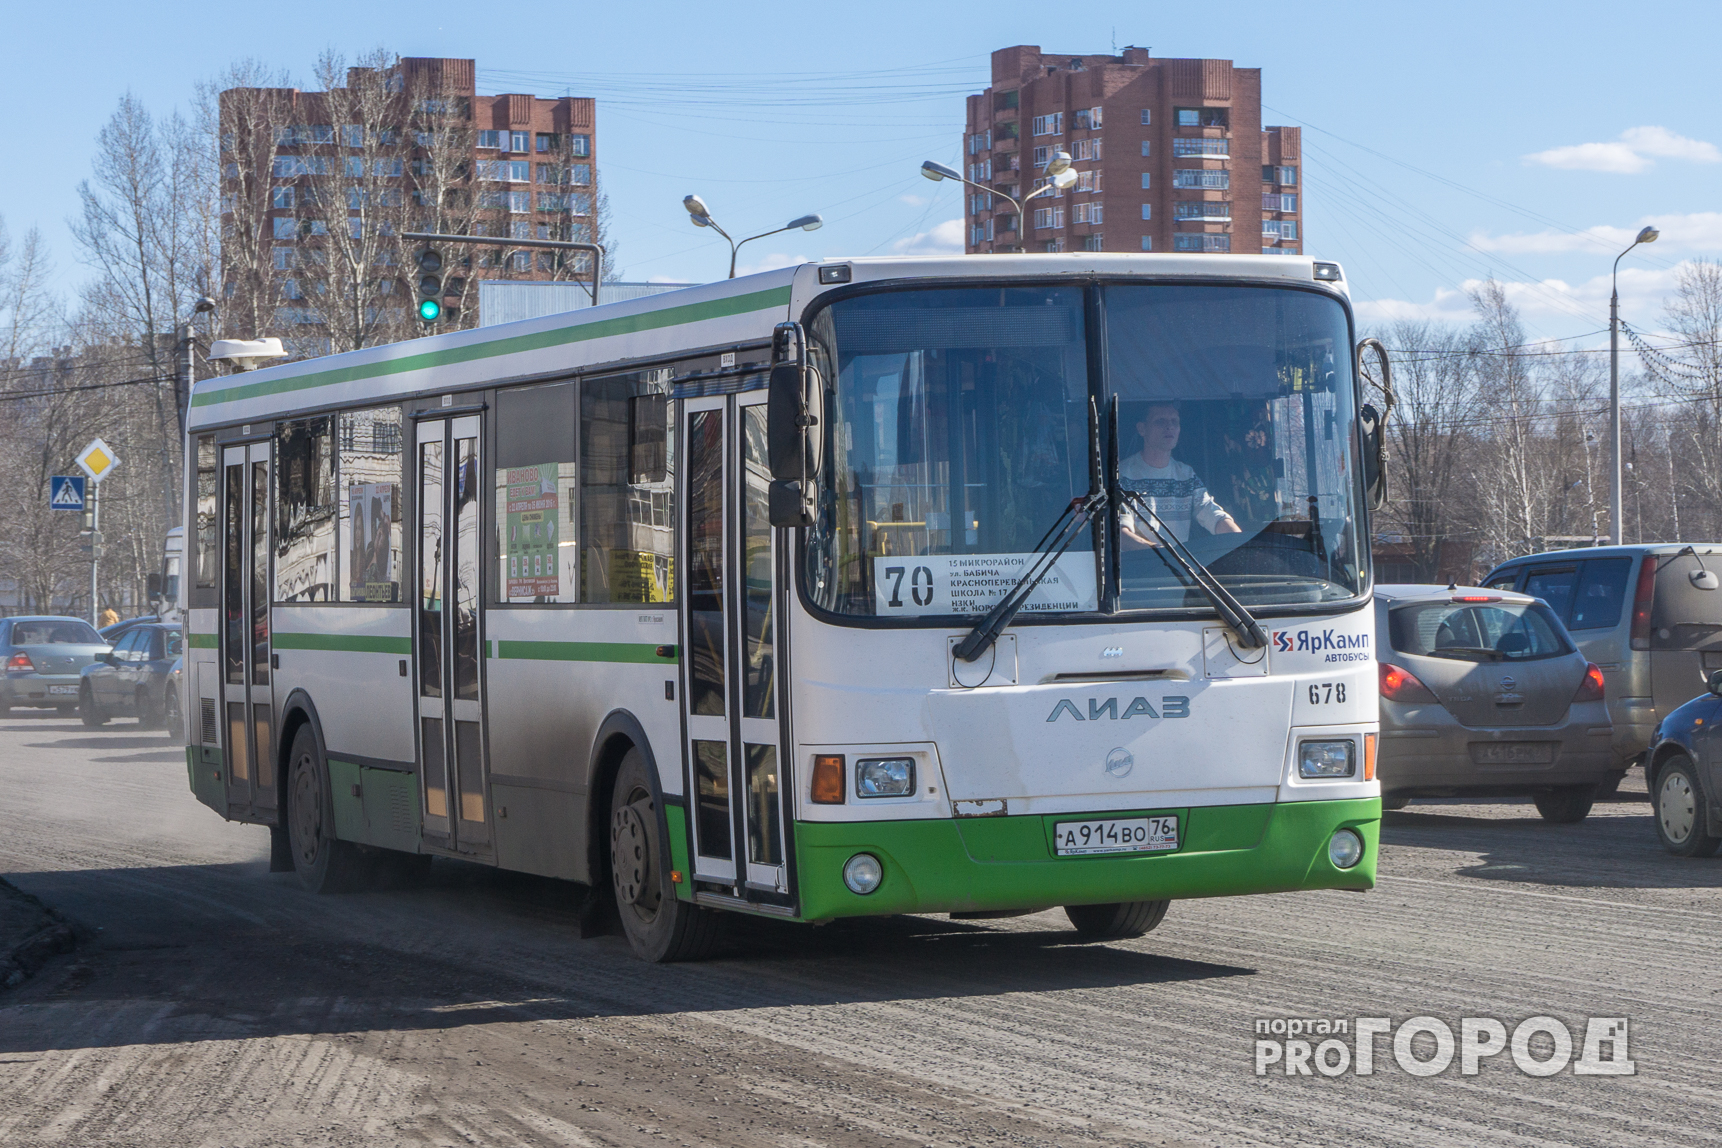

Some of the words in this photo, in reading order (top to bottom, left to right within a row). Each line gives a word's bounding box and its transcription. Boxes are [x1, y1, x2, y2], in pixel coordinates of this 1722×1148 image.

[507, 467, 538, 484] ИВАНОВО
[960, 557, 1024, 567] МИКРОРАЙОН
[964, 569, 1000, 577] БАБИЧА
[885, 566, 933, 607] 70
[950, 577, 1058, 587] КРАСНОПЕРЕВЛЬКАЯ
[951, 589, 985, 597] ШКОЛА
[1020, 602, 1078, 611] РЕЗИДЕНЦИИ
[1297, 629, 1369, 654] ЯрКамп
[1325, 653, 1369, 662] АВТОБУСЫ
[1309, 683, 1346, 704] 678
[1046, 696, 1190, 722] ЛИАЗ
[1065, 823, 1146, 846] А914ВО
[1151, 819, 1170, 835] 76
